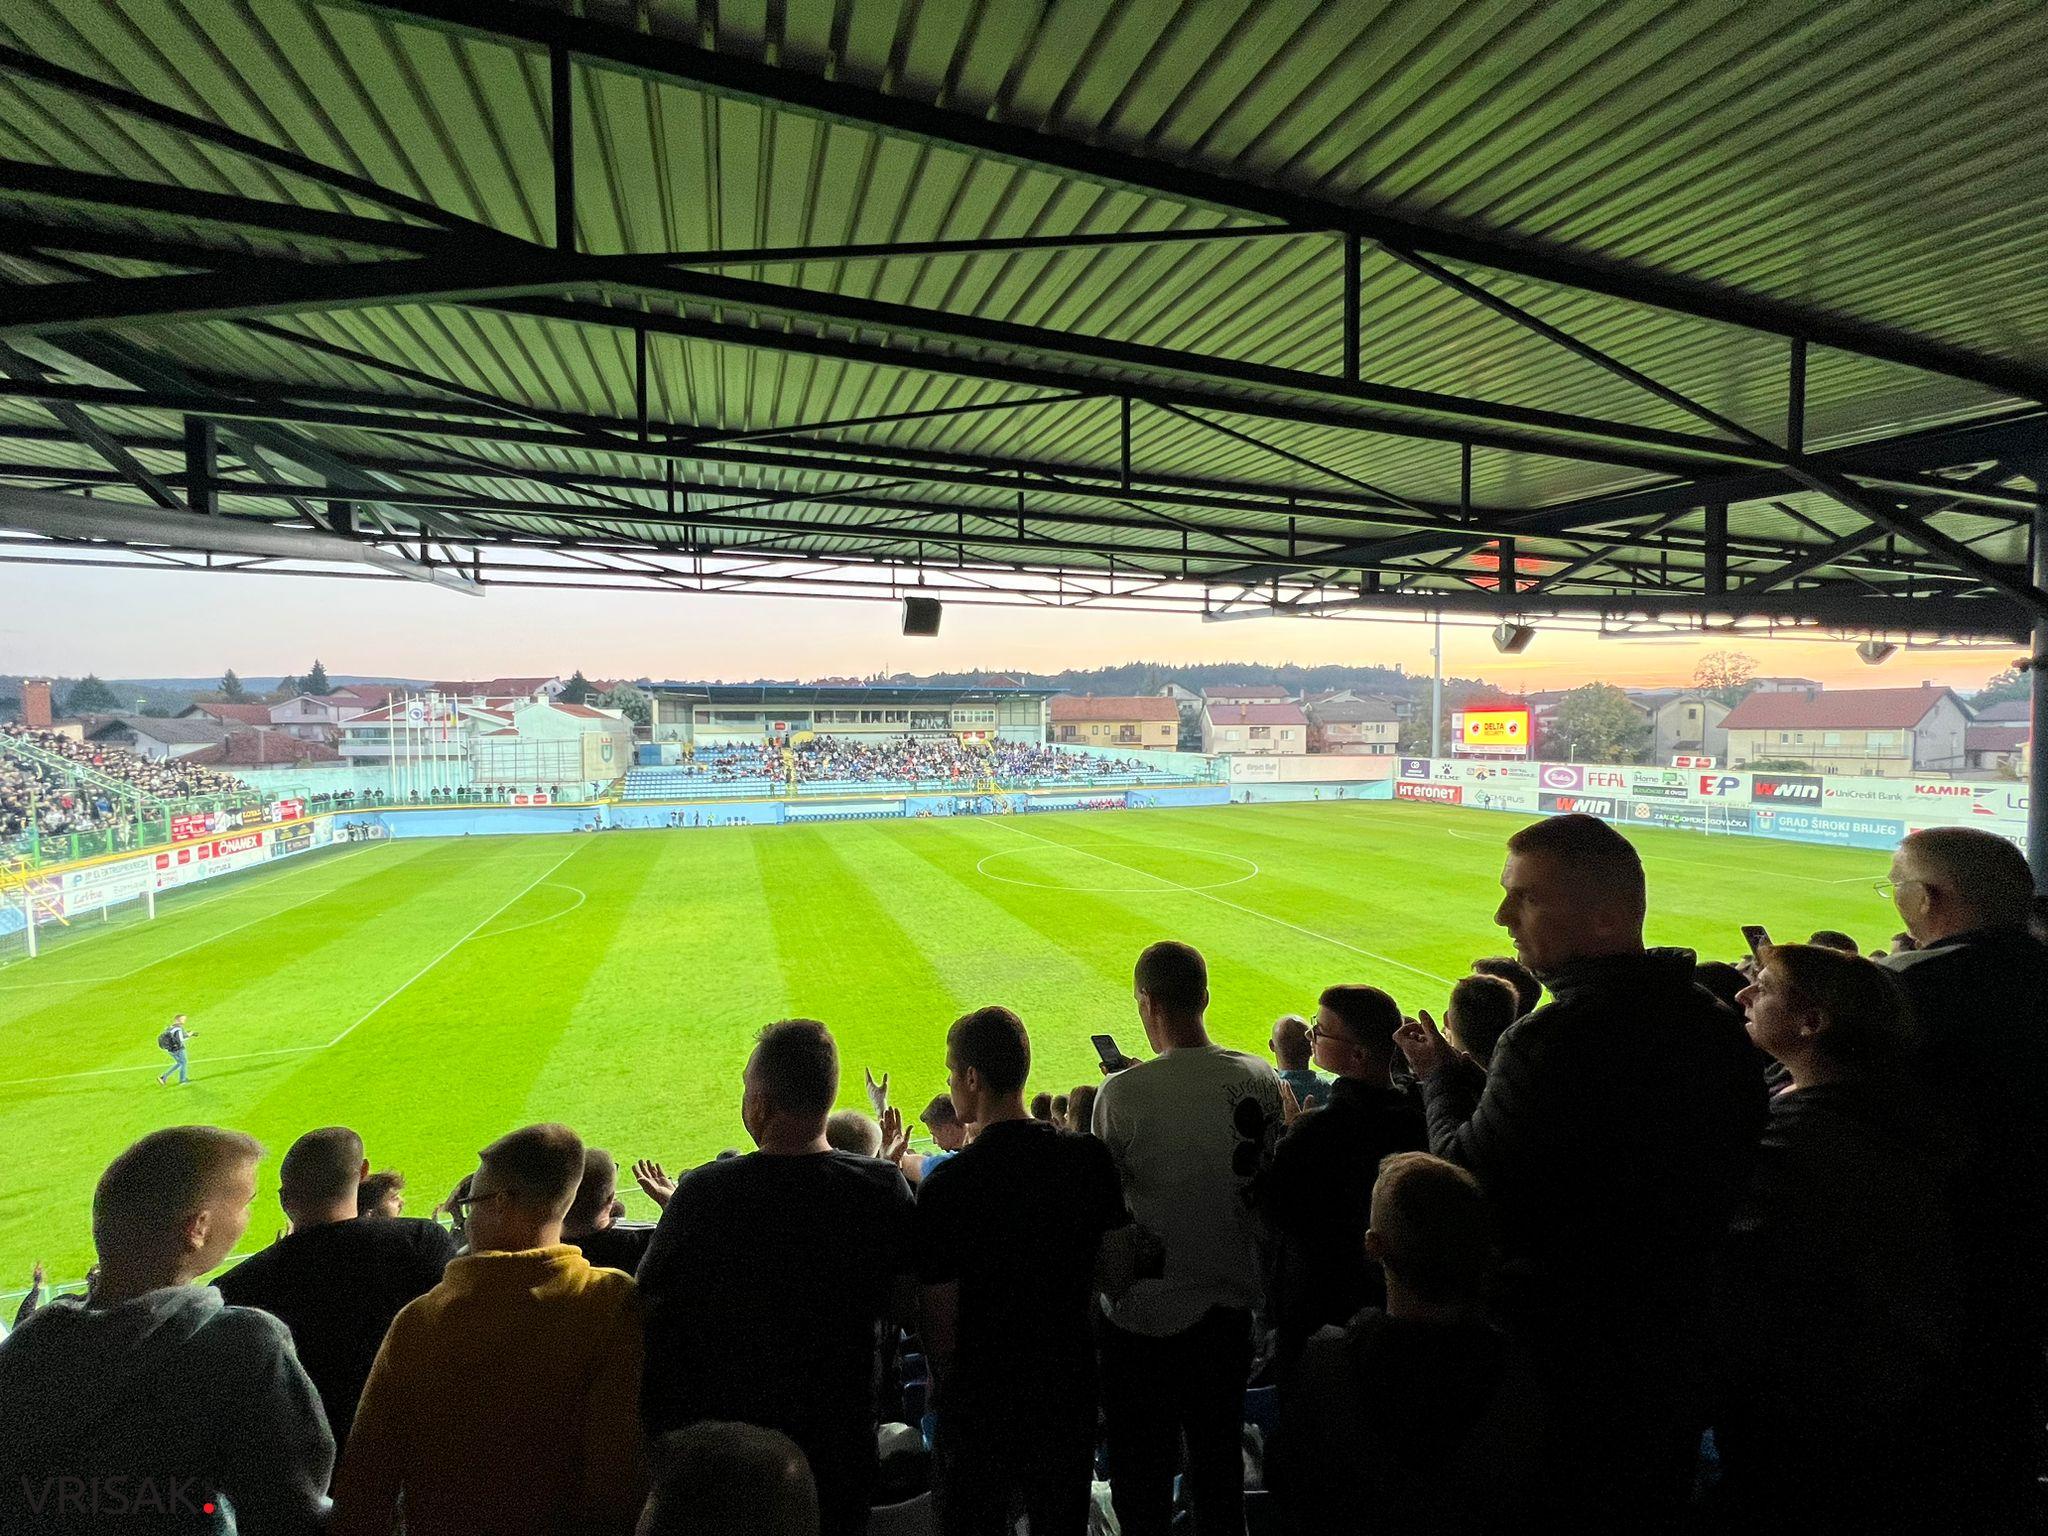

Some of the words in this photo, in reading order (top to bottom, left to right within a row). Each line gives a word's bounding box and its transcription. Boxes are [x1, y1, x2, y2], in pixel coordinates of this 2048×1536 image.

[1836, 790, 1876, 799] UniCredit
[1878, 791, 1903, 801] Bank
[1915, 785, 1971, 797] KAMIR
[1779, 817, 1809, 827] GRAD
[1811, 816, 1849, 831] ŠIROKI
[1853, 822, 1897, 836] BRIJEG
